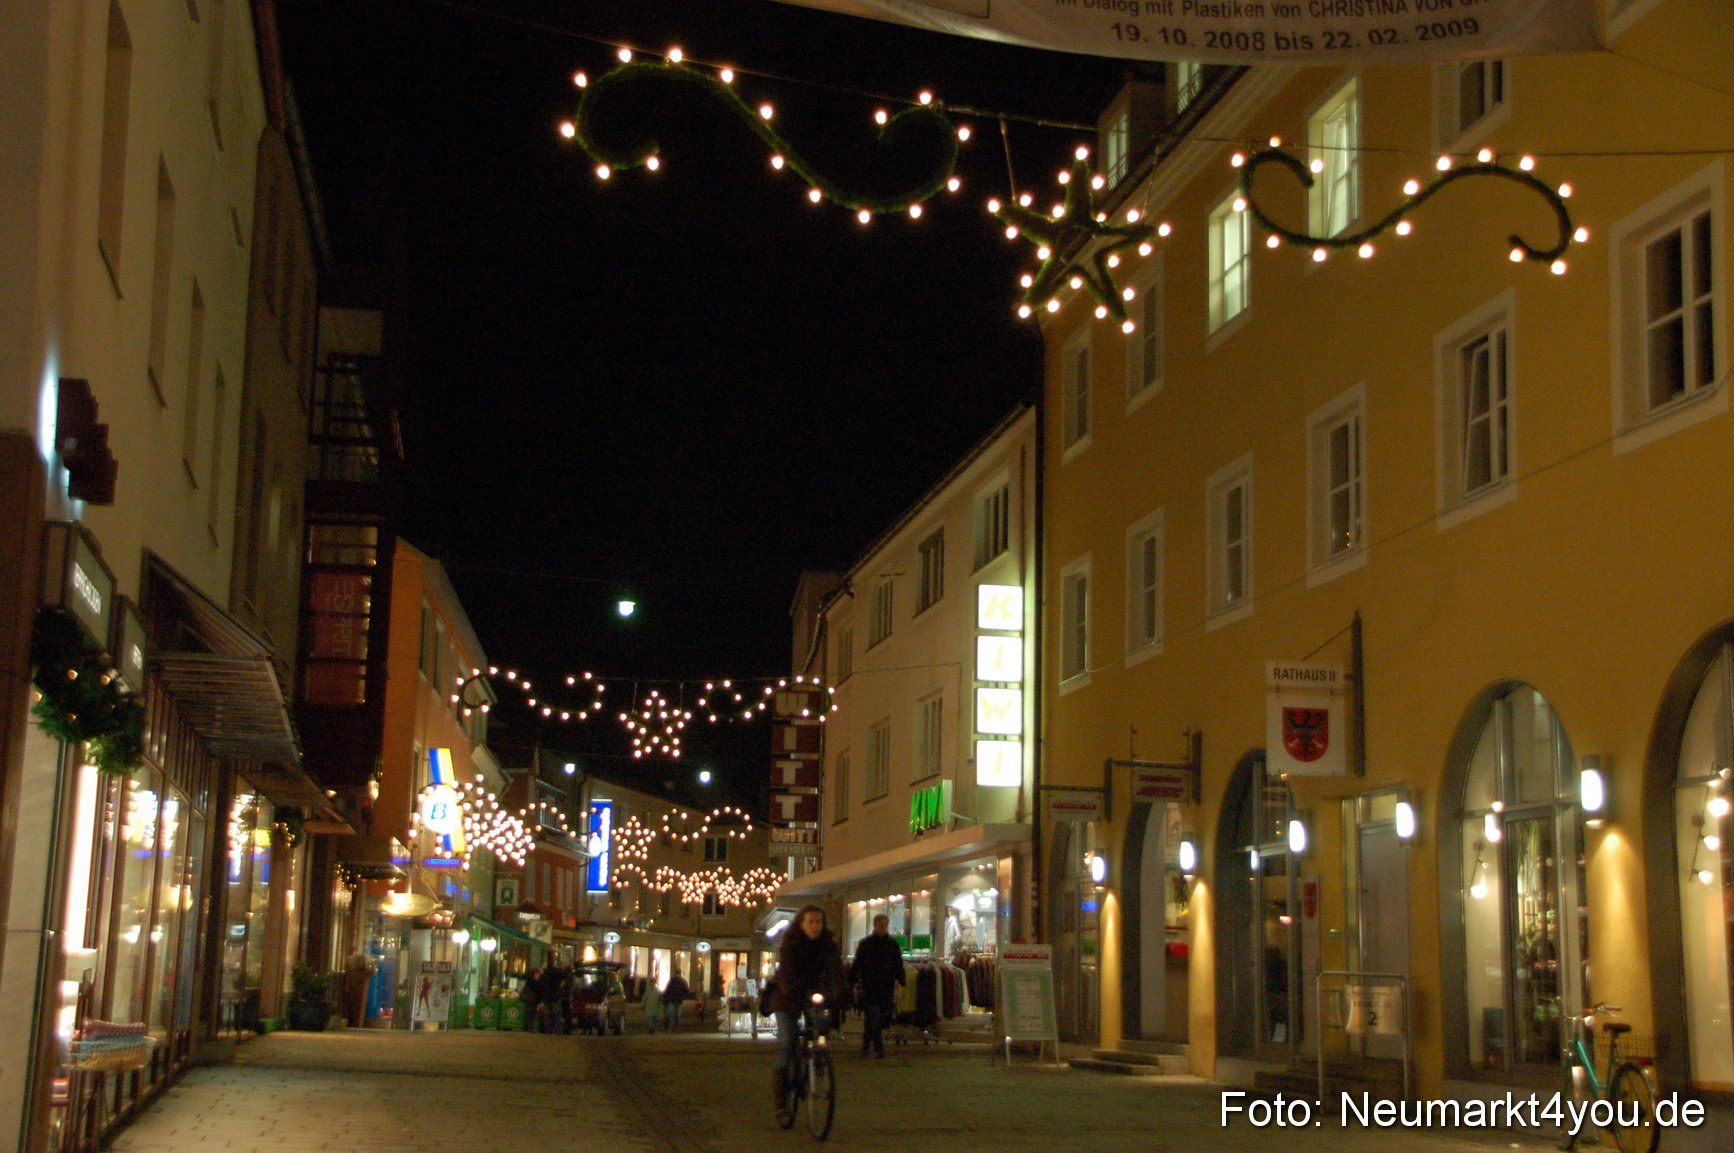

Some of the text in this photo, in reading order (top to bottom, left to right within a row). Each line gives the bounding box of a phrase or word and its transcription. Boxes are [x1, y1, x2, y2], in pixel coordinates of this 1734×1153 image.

[1083, 0, 1139, 17] Dialog
[1145, 0, 1174, 16] mit
[1182, 0, 1264, 18] Plastiken
[1270, 3, 1301, 18] von
[1308, 0, 1409, 18] CHRISTINA
[1415, 0, 1453, 12] VON
[1111, 17, 1479, 52] 19. 10. 2008 bis 22. 02. 2009
[1272, 667, 1327, 682] RATHAUS
[980, 593, 1014, 776] KIWI
[1368, 1011, 1378, 1026] 2
